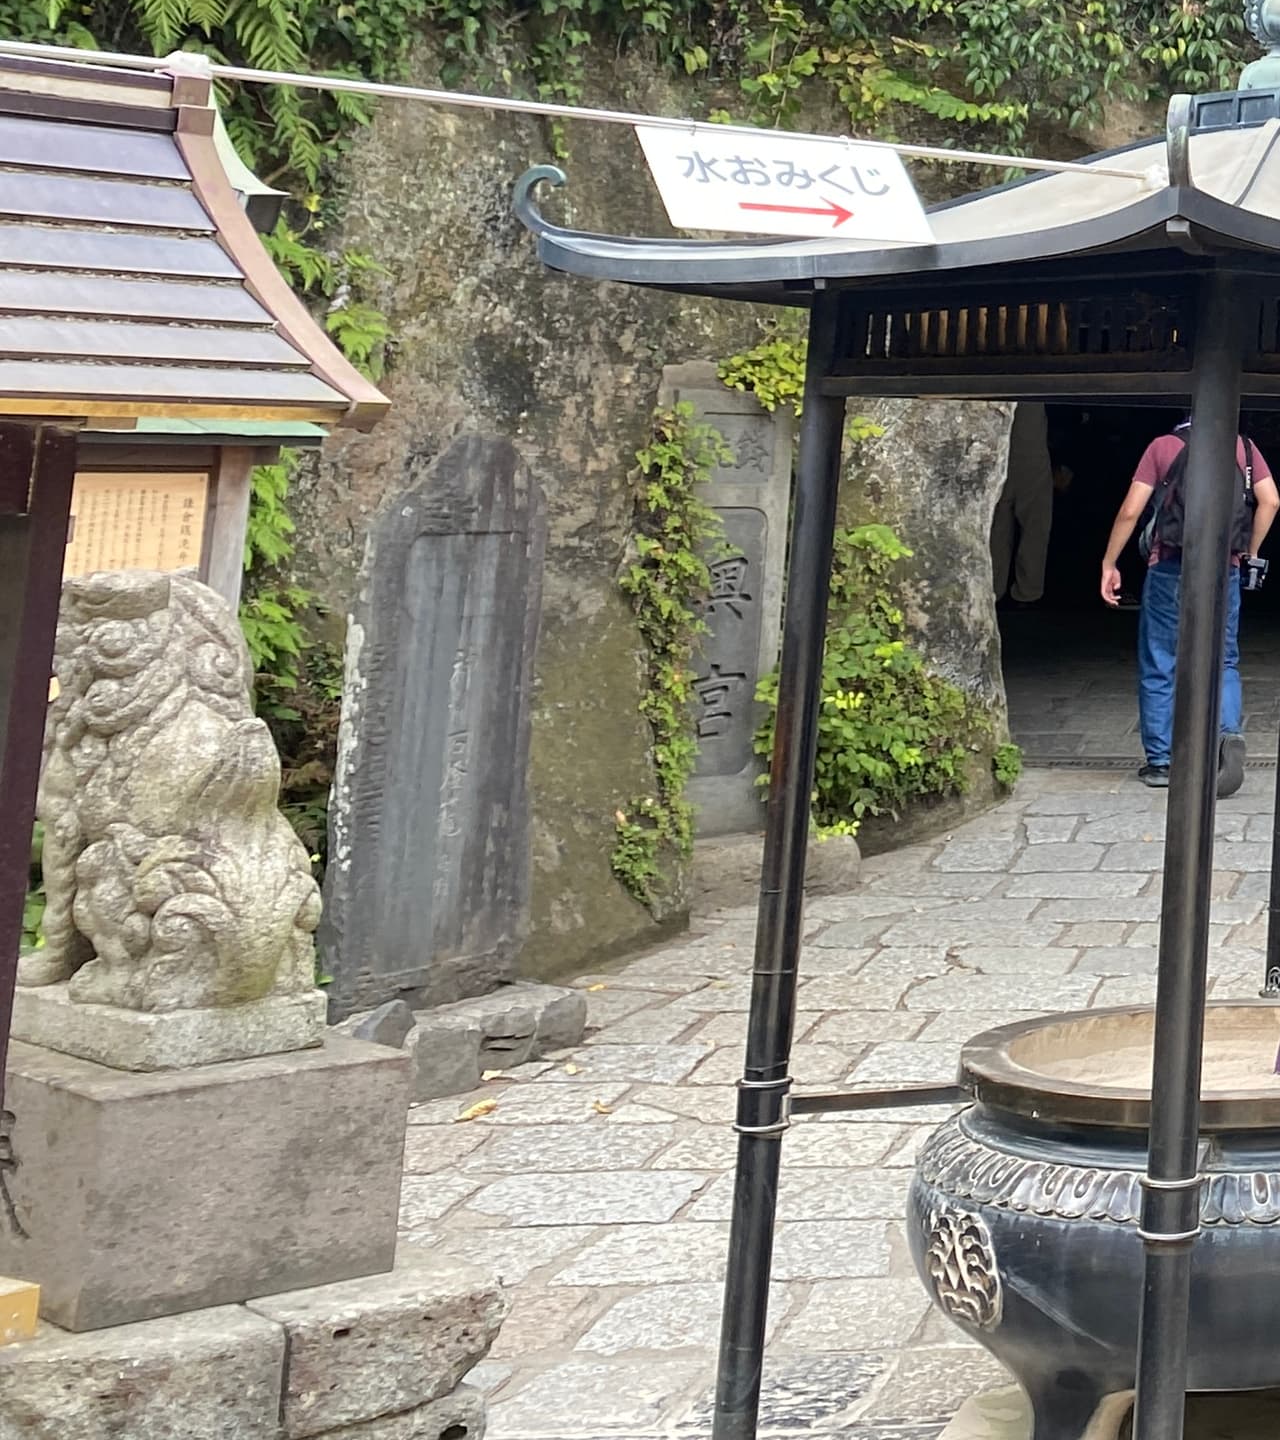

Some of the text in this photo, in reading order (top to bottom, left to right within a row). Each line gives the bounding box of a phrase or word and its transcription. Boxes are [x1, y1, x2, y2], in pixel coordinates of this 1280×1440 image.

[675, 150, 892, 197] 水おみくじ
